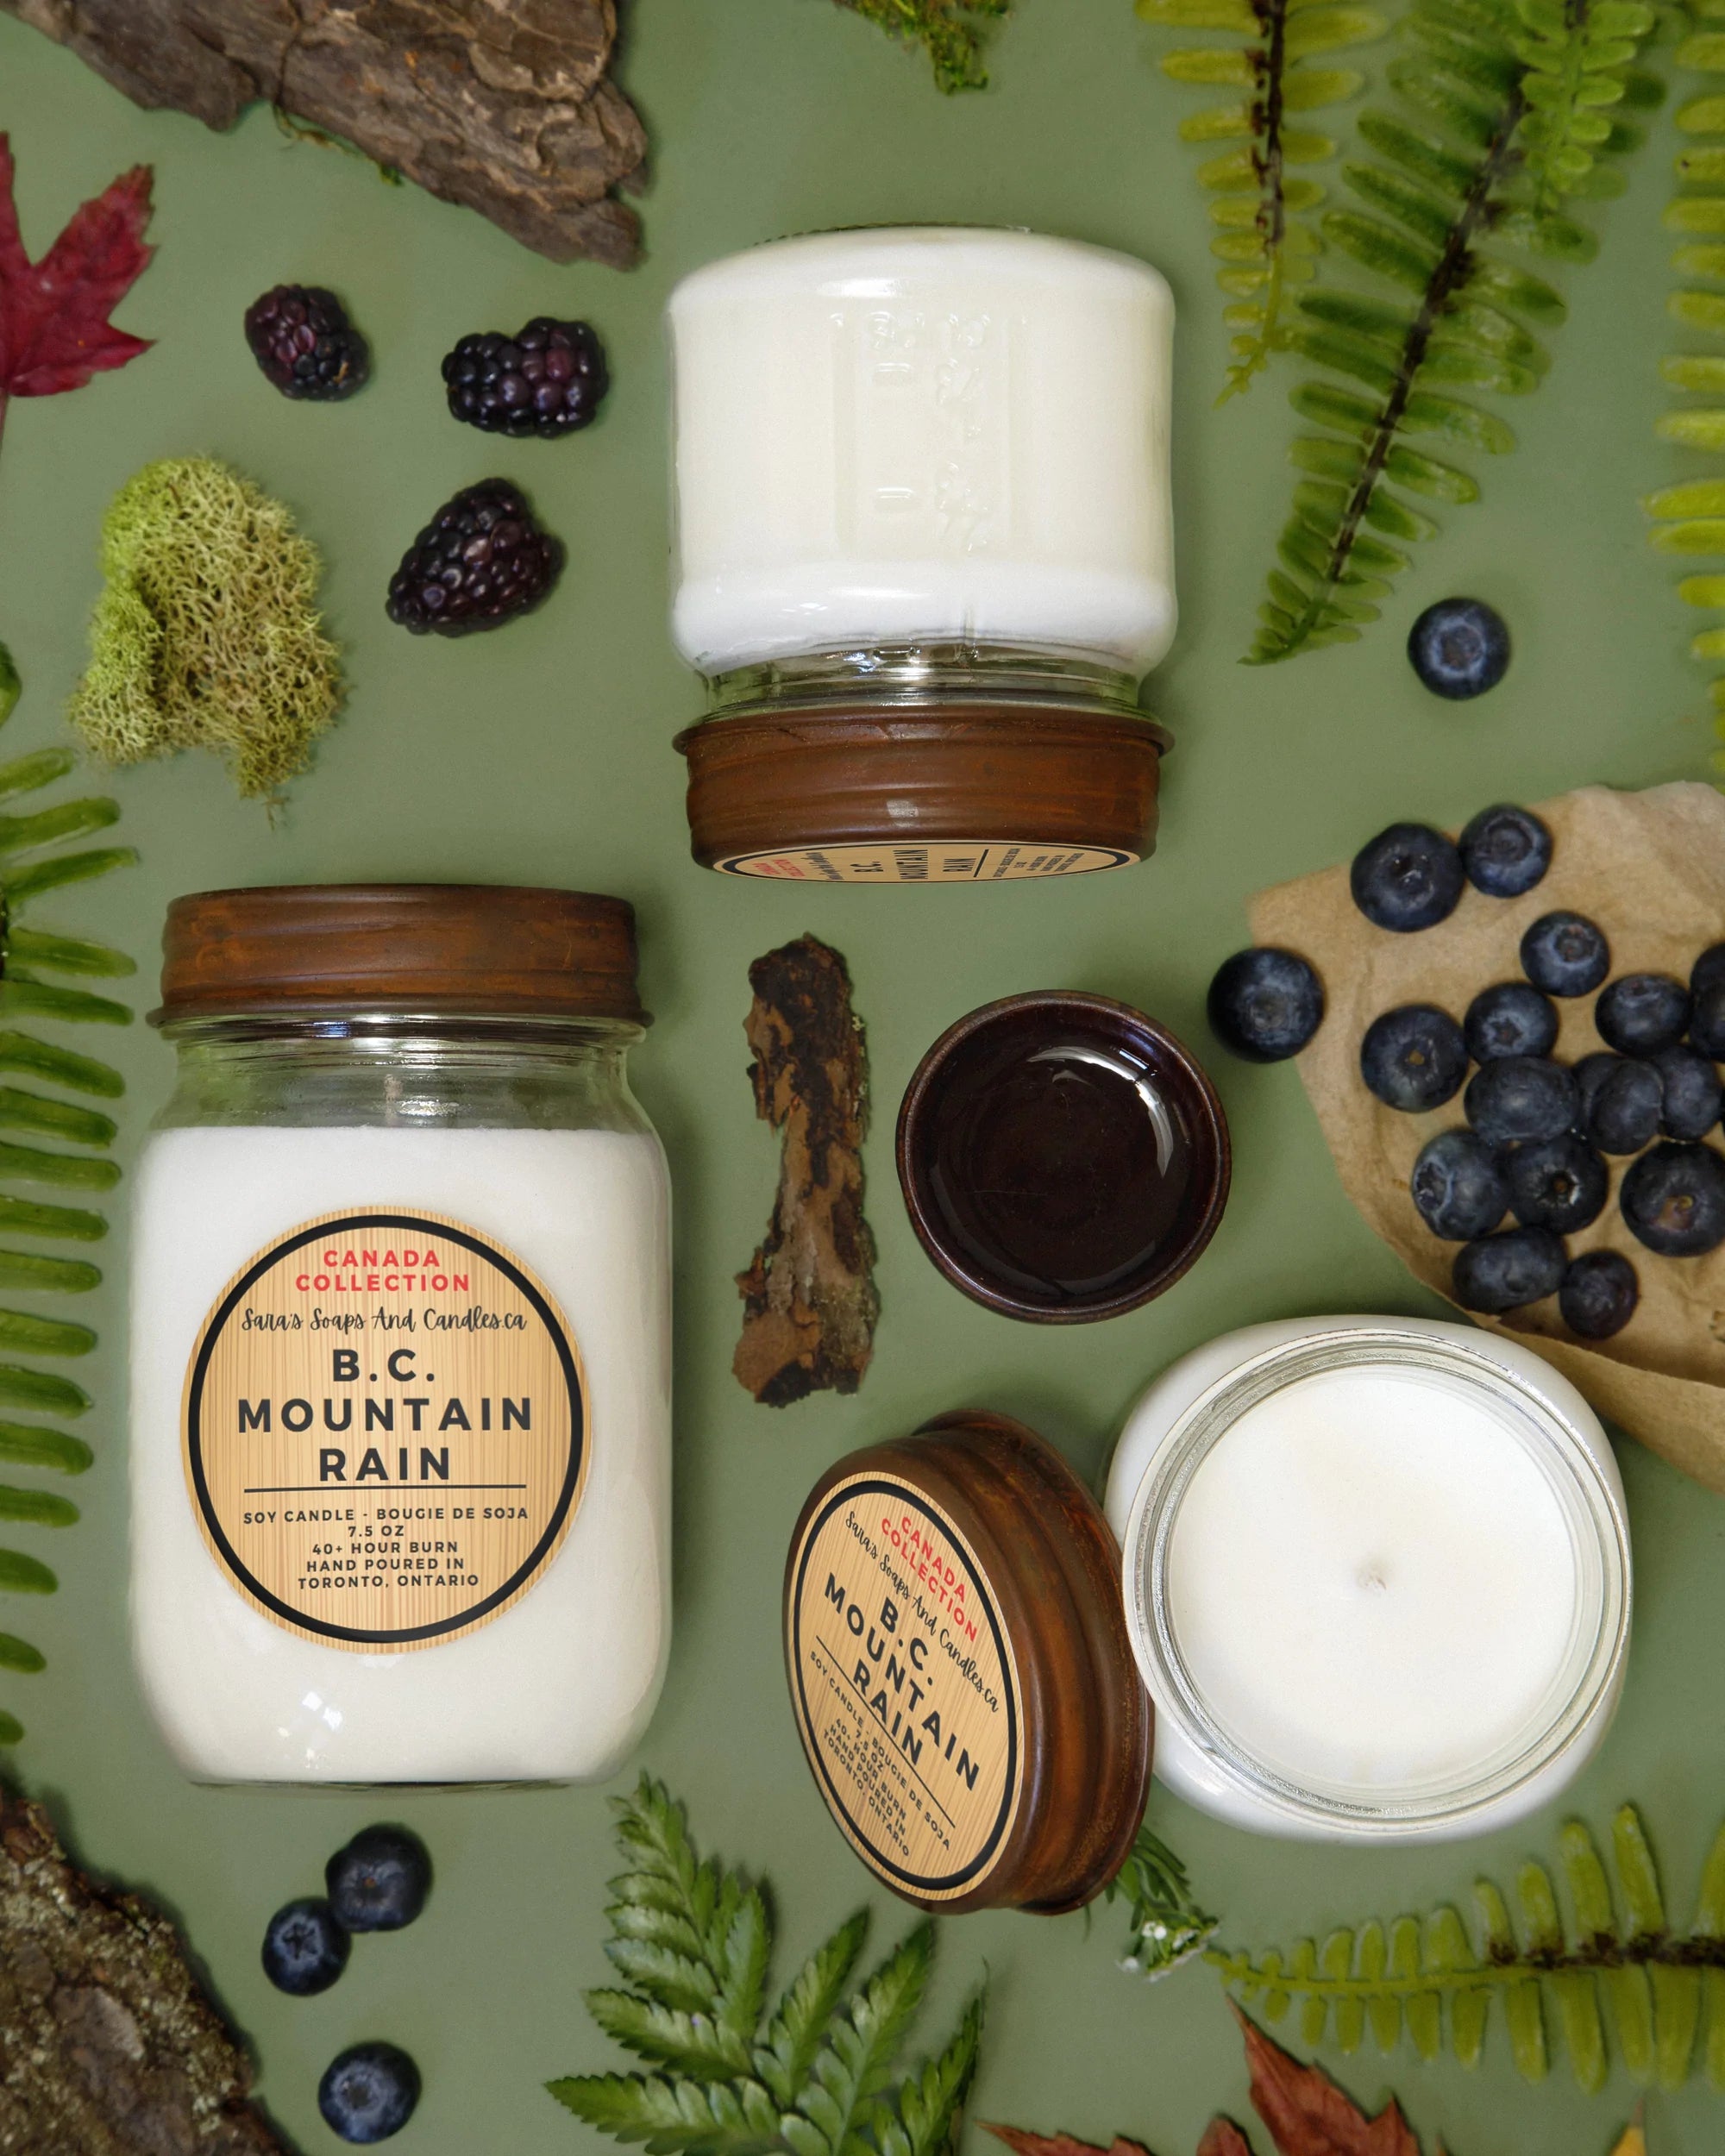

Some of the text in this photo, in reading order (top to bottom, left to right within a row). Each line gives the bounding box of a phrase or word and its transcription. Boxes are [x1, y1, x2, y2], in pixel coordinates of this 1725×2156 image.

[893, 849, 929, 880] MOUNTAIN
[943, 857, 976, 873] RAIN
[323, 1250, 440, 1268] CANADA
[295, 1274, 469, 1292] COLLECTION
[242, 1305, 528, 1335] Sara's Soaps And Candles.ca
[333, 1349, 435, 1382] B.C.
[238, 1397, 531, 1433] MOUNTAIN
[319, 1447, 450, 1482] RAIN
[243, 1513, 277, 1525] SOY
[284, 1509, 354, 1523] CANDLE
[377, 1507, 444, 1520] BOUGIE
[453, 1507, 475, 1520] DE
[483, 1507, 528, 1520] SOJA
[348, 1525, 405, 1538] 7.5 OZ
[307, 1557, 463, 1572] HAND POURED IN
[312, 1541, 457, 1556] 40+ HOUR BURN
[901, 1517, 965, 1603] CANADA
[298, 1574, 479, 1589] TORONTO, ONTARIO
[881, 1518, 977, 1642] COLLECTION
[845, 1511, 999, 1713] Sara's Soaps And Candles.ca
[880, 1596, 933, 1686] B.C.
[824, 1572, 980, 1791] MOUNTAIN
[852, 1658, 923, 1766] RAIN
[810, 1651, 828, 1676] SOY
[829, 1677, 863, 1728] CANDLE
[872, 1737, 907, 1789] BOUGIE
[909, 1789, 923, 1811] DE
[924, 1811, 950, 1851] SOJA
[856, 1729, 884, 1772] 7.5 OZ
[830, 1724, 906, 1836] HAND POURED IN
[836, 1718, 906, 1821] 40+ HOUR BURN
[824, 1729, 910, 1857] TORONTO, ONTARIO
